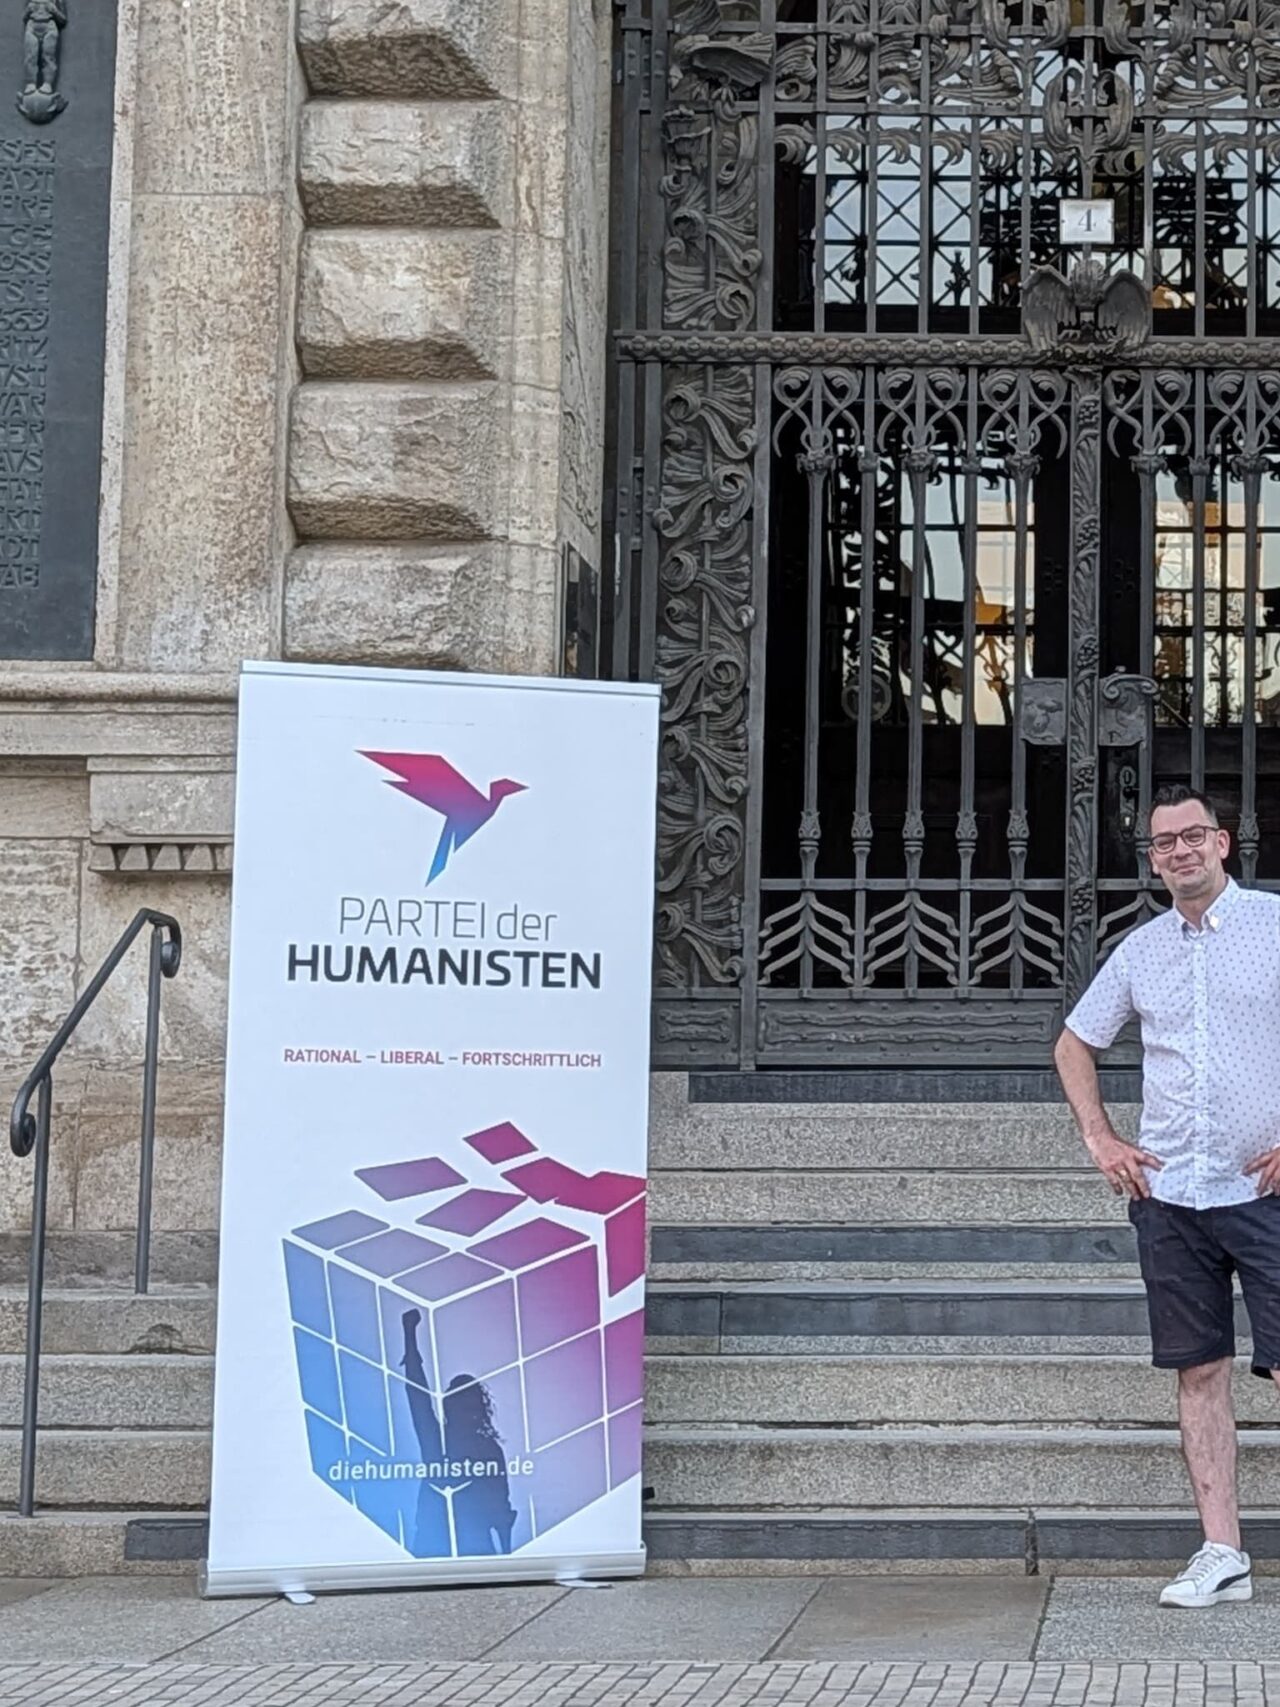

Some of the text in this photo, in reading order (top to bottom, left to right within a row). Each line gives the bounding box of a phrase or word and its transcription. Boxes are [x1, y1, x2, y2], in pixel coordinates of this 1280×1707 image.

[338, 896, 559, 942] PARTEI der
[287, 944, 602, 989] HUMANISTEN
[284, 1048, 362, 1064] RATIONAL
[380, 1050, 444, 1066] LIBERAL
[462, 1051, 602, 1068] FORTSCHRITTLICH
[328, 1456, 535, 1481] diehumanisten.de
